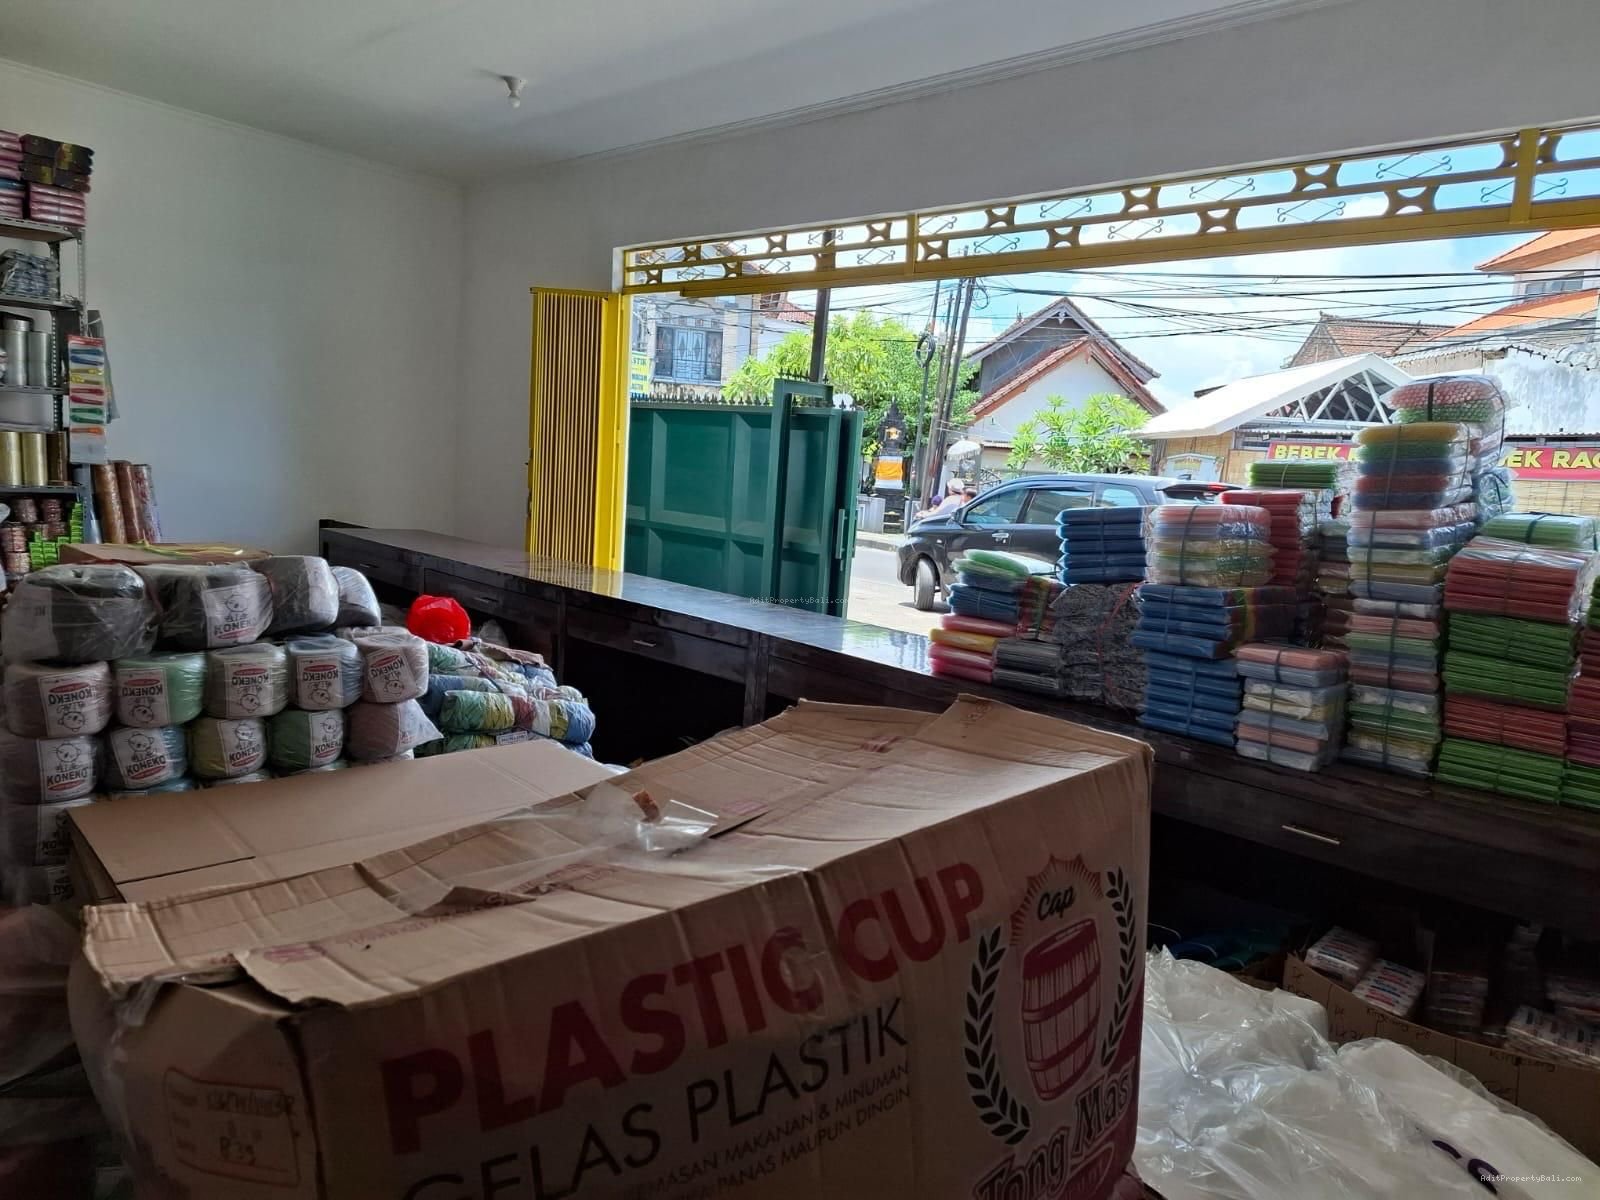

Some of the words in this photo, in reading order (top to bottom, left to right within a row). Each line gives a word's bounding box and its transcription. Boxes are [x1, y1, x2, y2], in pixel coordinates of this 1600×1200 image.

[1274, 444, 1342, 461] BEBEK
[232, 673, 269, 686] KONEKO
[303, 671, 339, 682] KONEKO
[48, 686, 94, 705] KONEKO
[122, 685, 163, 697] KONEKO
[47, 766, 88, 786] KONEKO
[126, 755, 166, 776] KONEKO
[1038, 886, 1073, 920] Cap
[380, 926, 823, 1155] PLASTIC
[836, 862, 984, 983] CUP
[686, 997, 908, 1142] PLASTIK
[724, 1111, 814, 1162] MAKANAN
[834, 1060, 910, 1113] MINUMAN
[1072, 1063, 1134, 1156] Mas
[781, 1119, 851, 1166] MAUPUN
[856, 1085, 911, 1127] DINGIN
